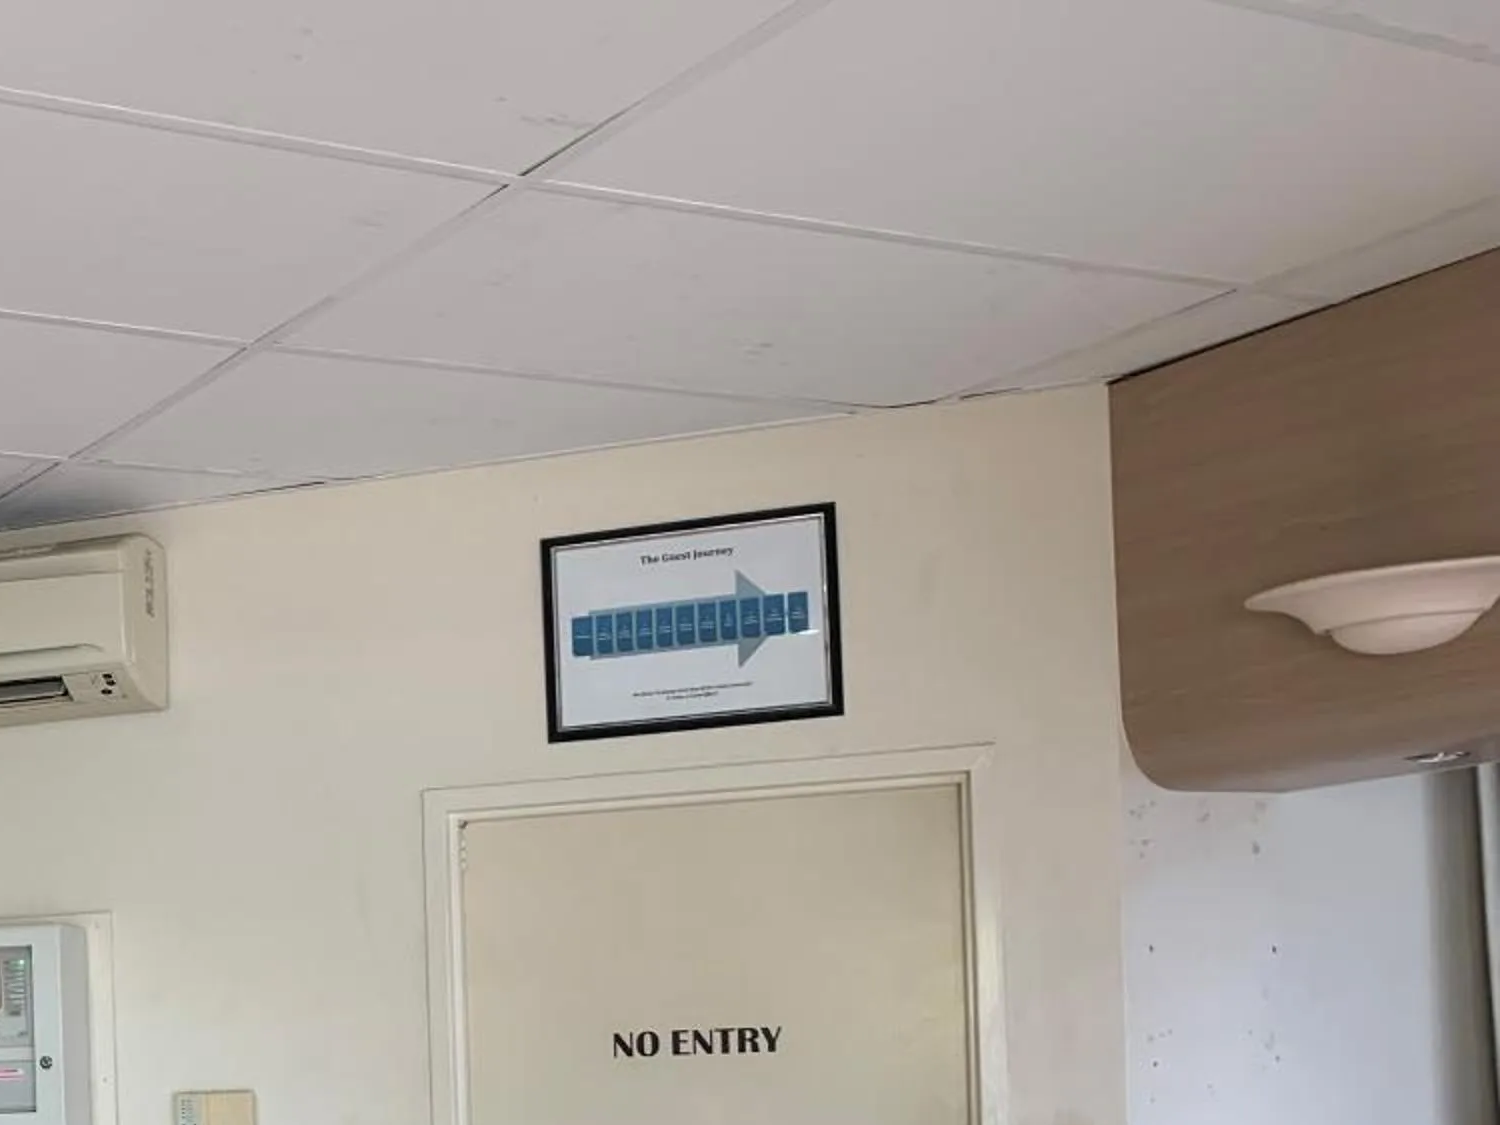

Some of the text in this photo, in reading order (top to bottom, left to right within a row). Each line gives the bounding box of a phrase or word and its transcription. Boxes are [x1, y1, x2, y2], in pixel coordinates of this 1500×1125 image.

[640, 547, 734, 566] The Guest Journey
[612, 1026, 782, 1059] NO ENTRY
